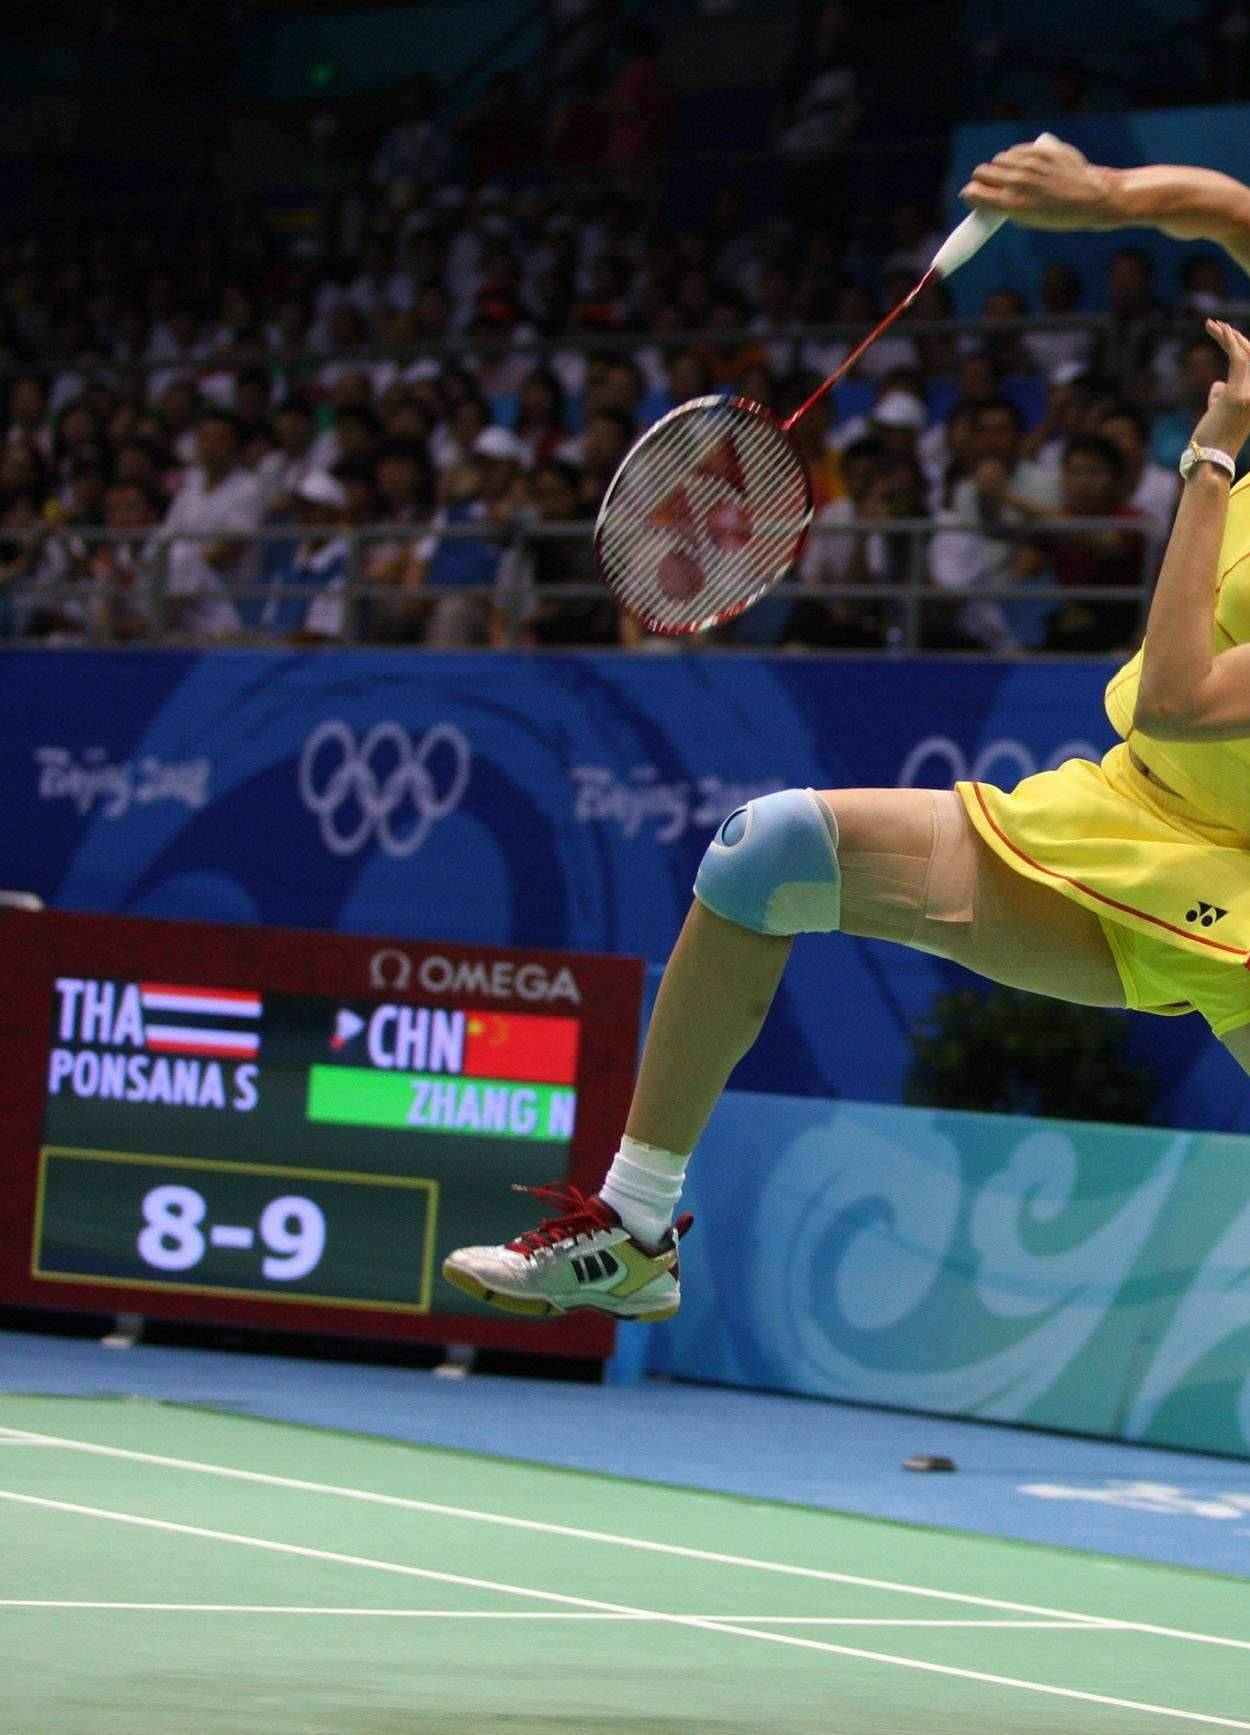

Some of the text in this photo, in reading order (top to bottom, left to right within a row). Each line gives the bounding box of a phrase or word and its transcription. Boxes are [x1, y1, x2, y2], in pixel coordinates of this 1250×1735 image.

[419, 955, 581, 1003] OMEGA
[55, 977, 145, 1046] THA
[367, 1004, 465, 1074] CHN
[49, 1049, 260, 1112] PONSANA S
[406, 1080, 577, 1140] ZHANG N
